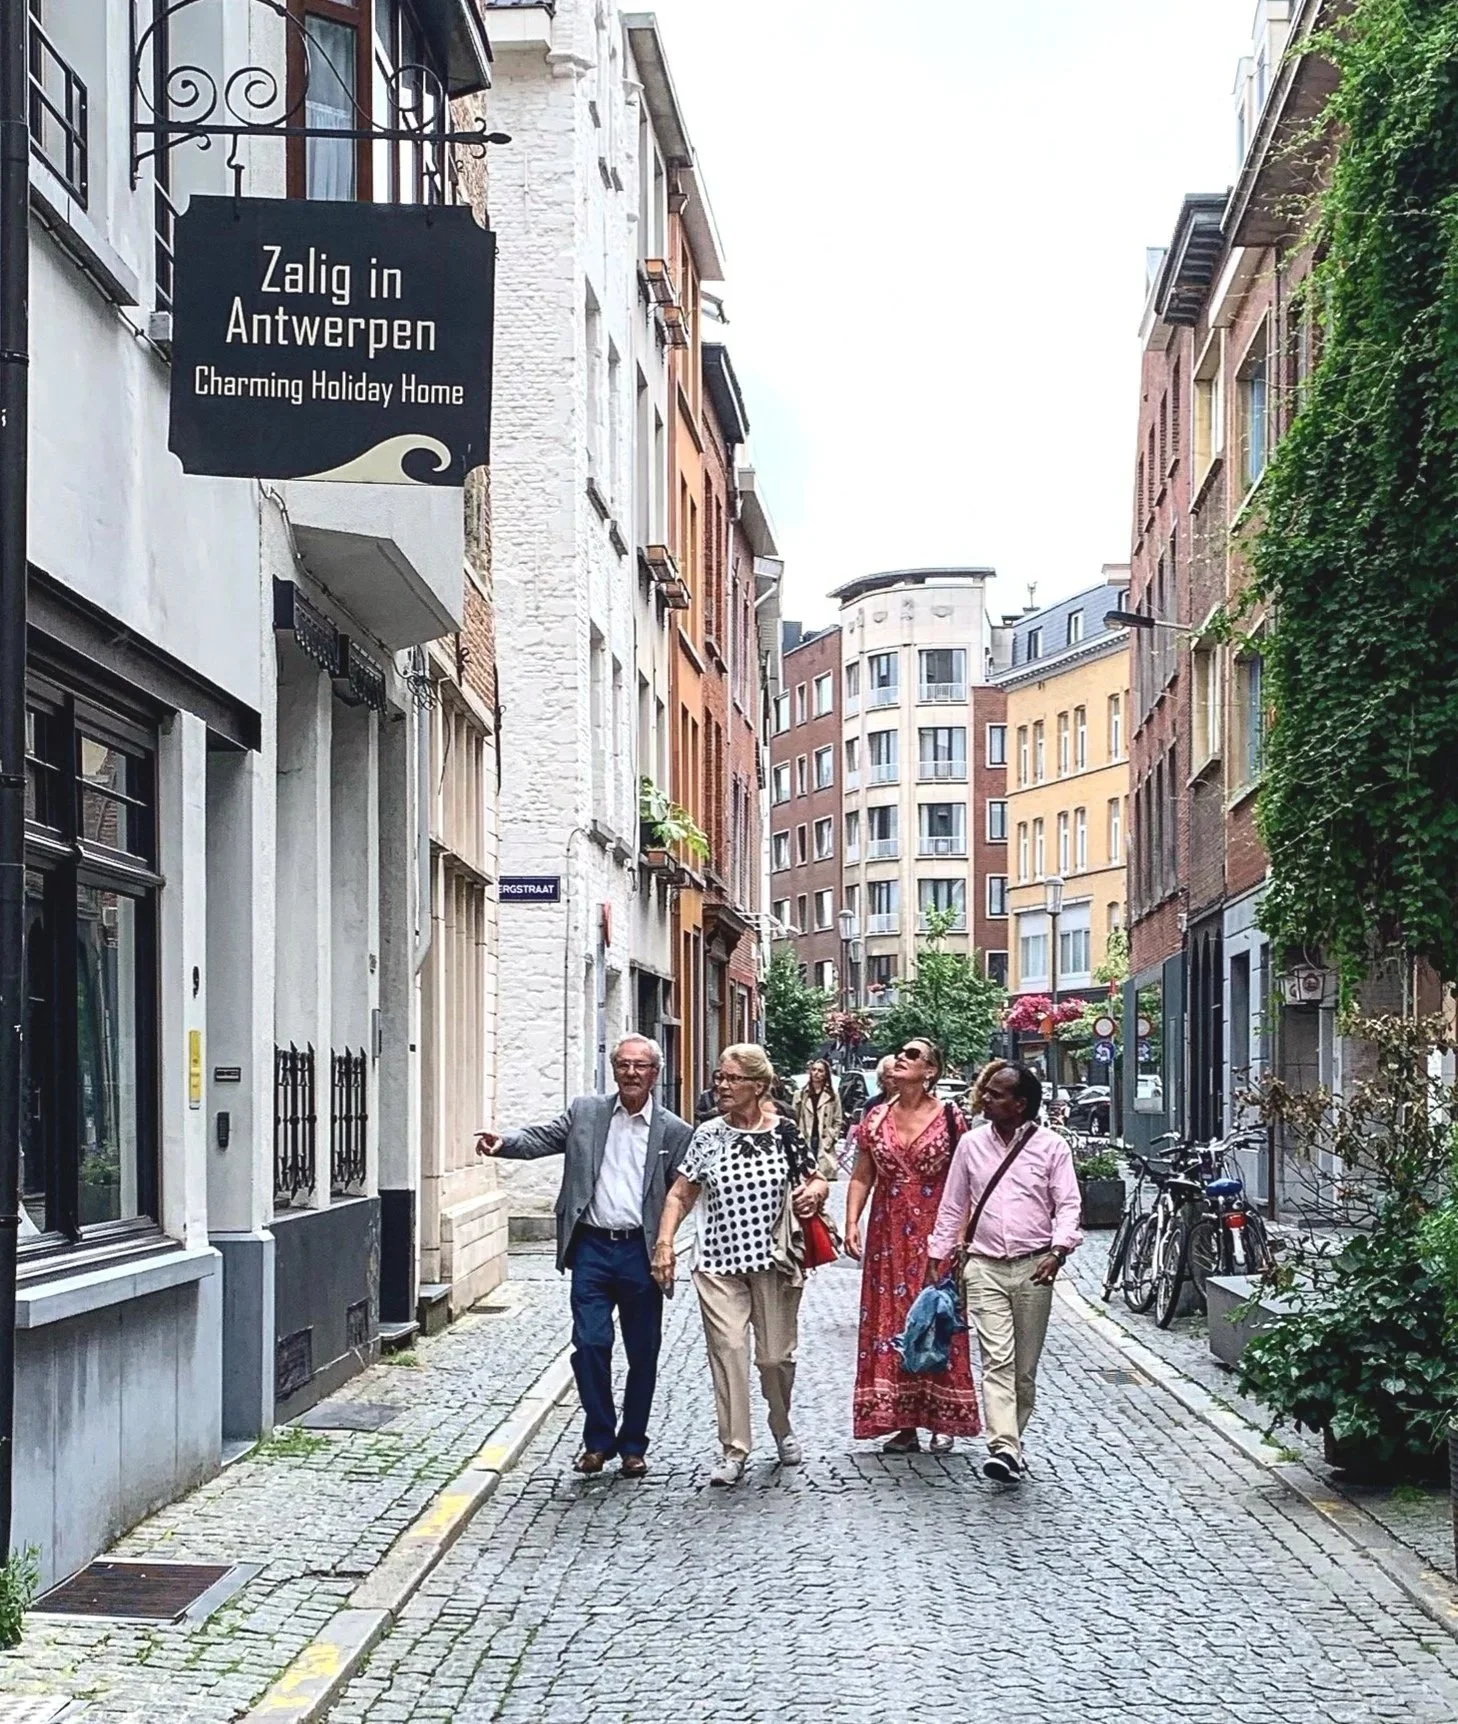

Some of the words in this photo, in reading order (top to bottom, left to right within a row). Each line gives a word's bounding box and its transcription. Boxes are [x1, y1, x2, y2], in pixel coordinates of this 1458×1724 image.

[261, 245, 351, 306] Zalig
[370, 257, 402, 299] in
[225, 296, 436, 359] Antwerpen
[195, 365, 303, 405] Charming
[312, 369, 393, 408] Holiday
[401, 373, 464, 405] Home
